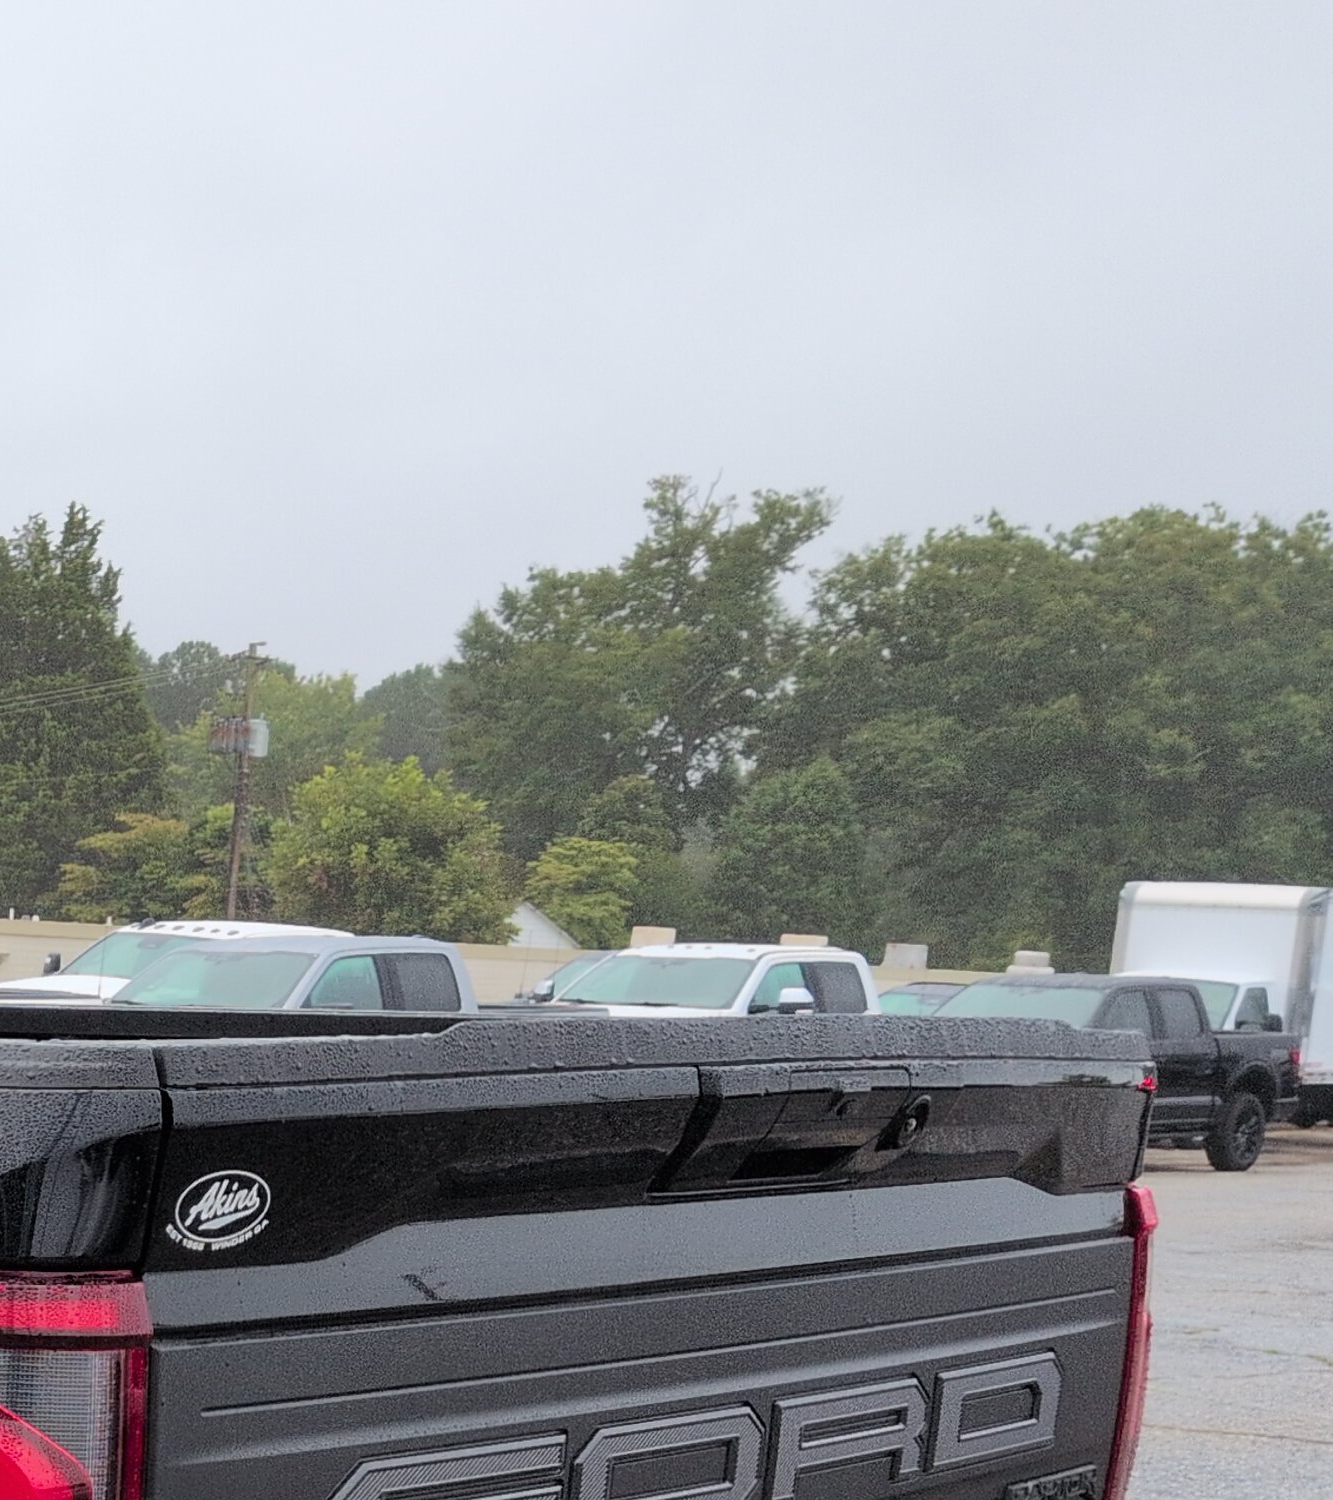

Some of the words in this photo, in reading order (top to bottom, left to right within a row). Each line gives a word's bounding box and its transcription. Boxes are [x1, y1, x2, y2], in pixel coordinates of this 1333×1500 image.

[184, 1176, 261, 1230] Akins
[165, 1223, 183, 1243] EST
[211, 1230, 253, 1251] WINDER
